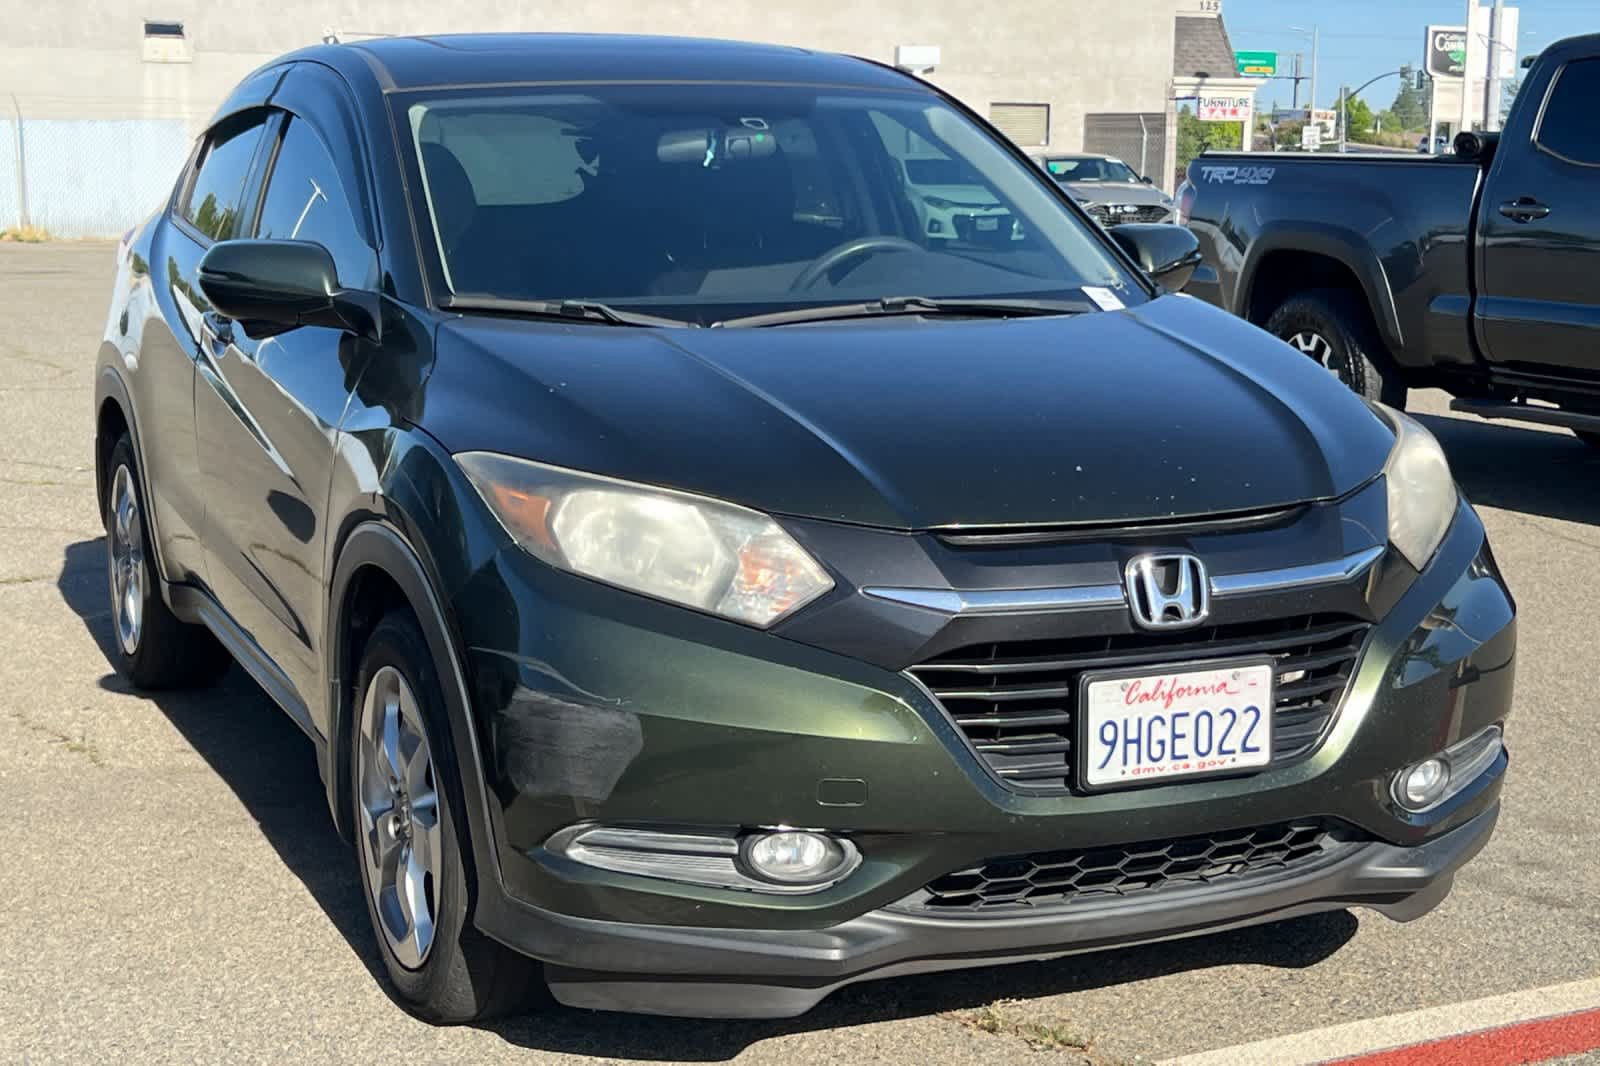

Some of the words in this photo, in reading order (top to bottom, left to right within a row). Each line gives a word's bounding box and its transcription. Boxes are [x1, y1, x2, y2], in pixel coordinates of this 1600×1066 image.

[1200, 1, 1218, 11] 125
[1198, 97, 1249, 108] FURNITURE
[1124, 677, 1241, 709] California
[1097, 705, 1261, 770] 9HGE022
